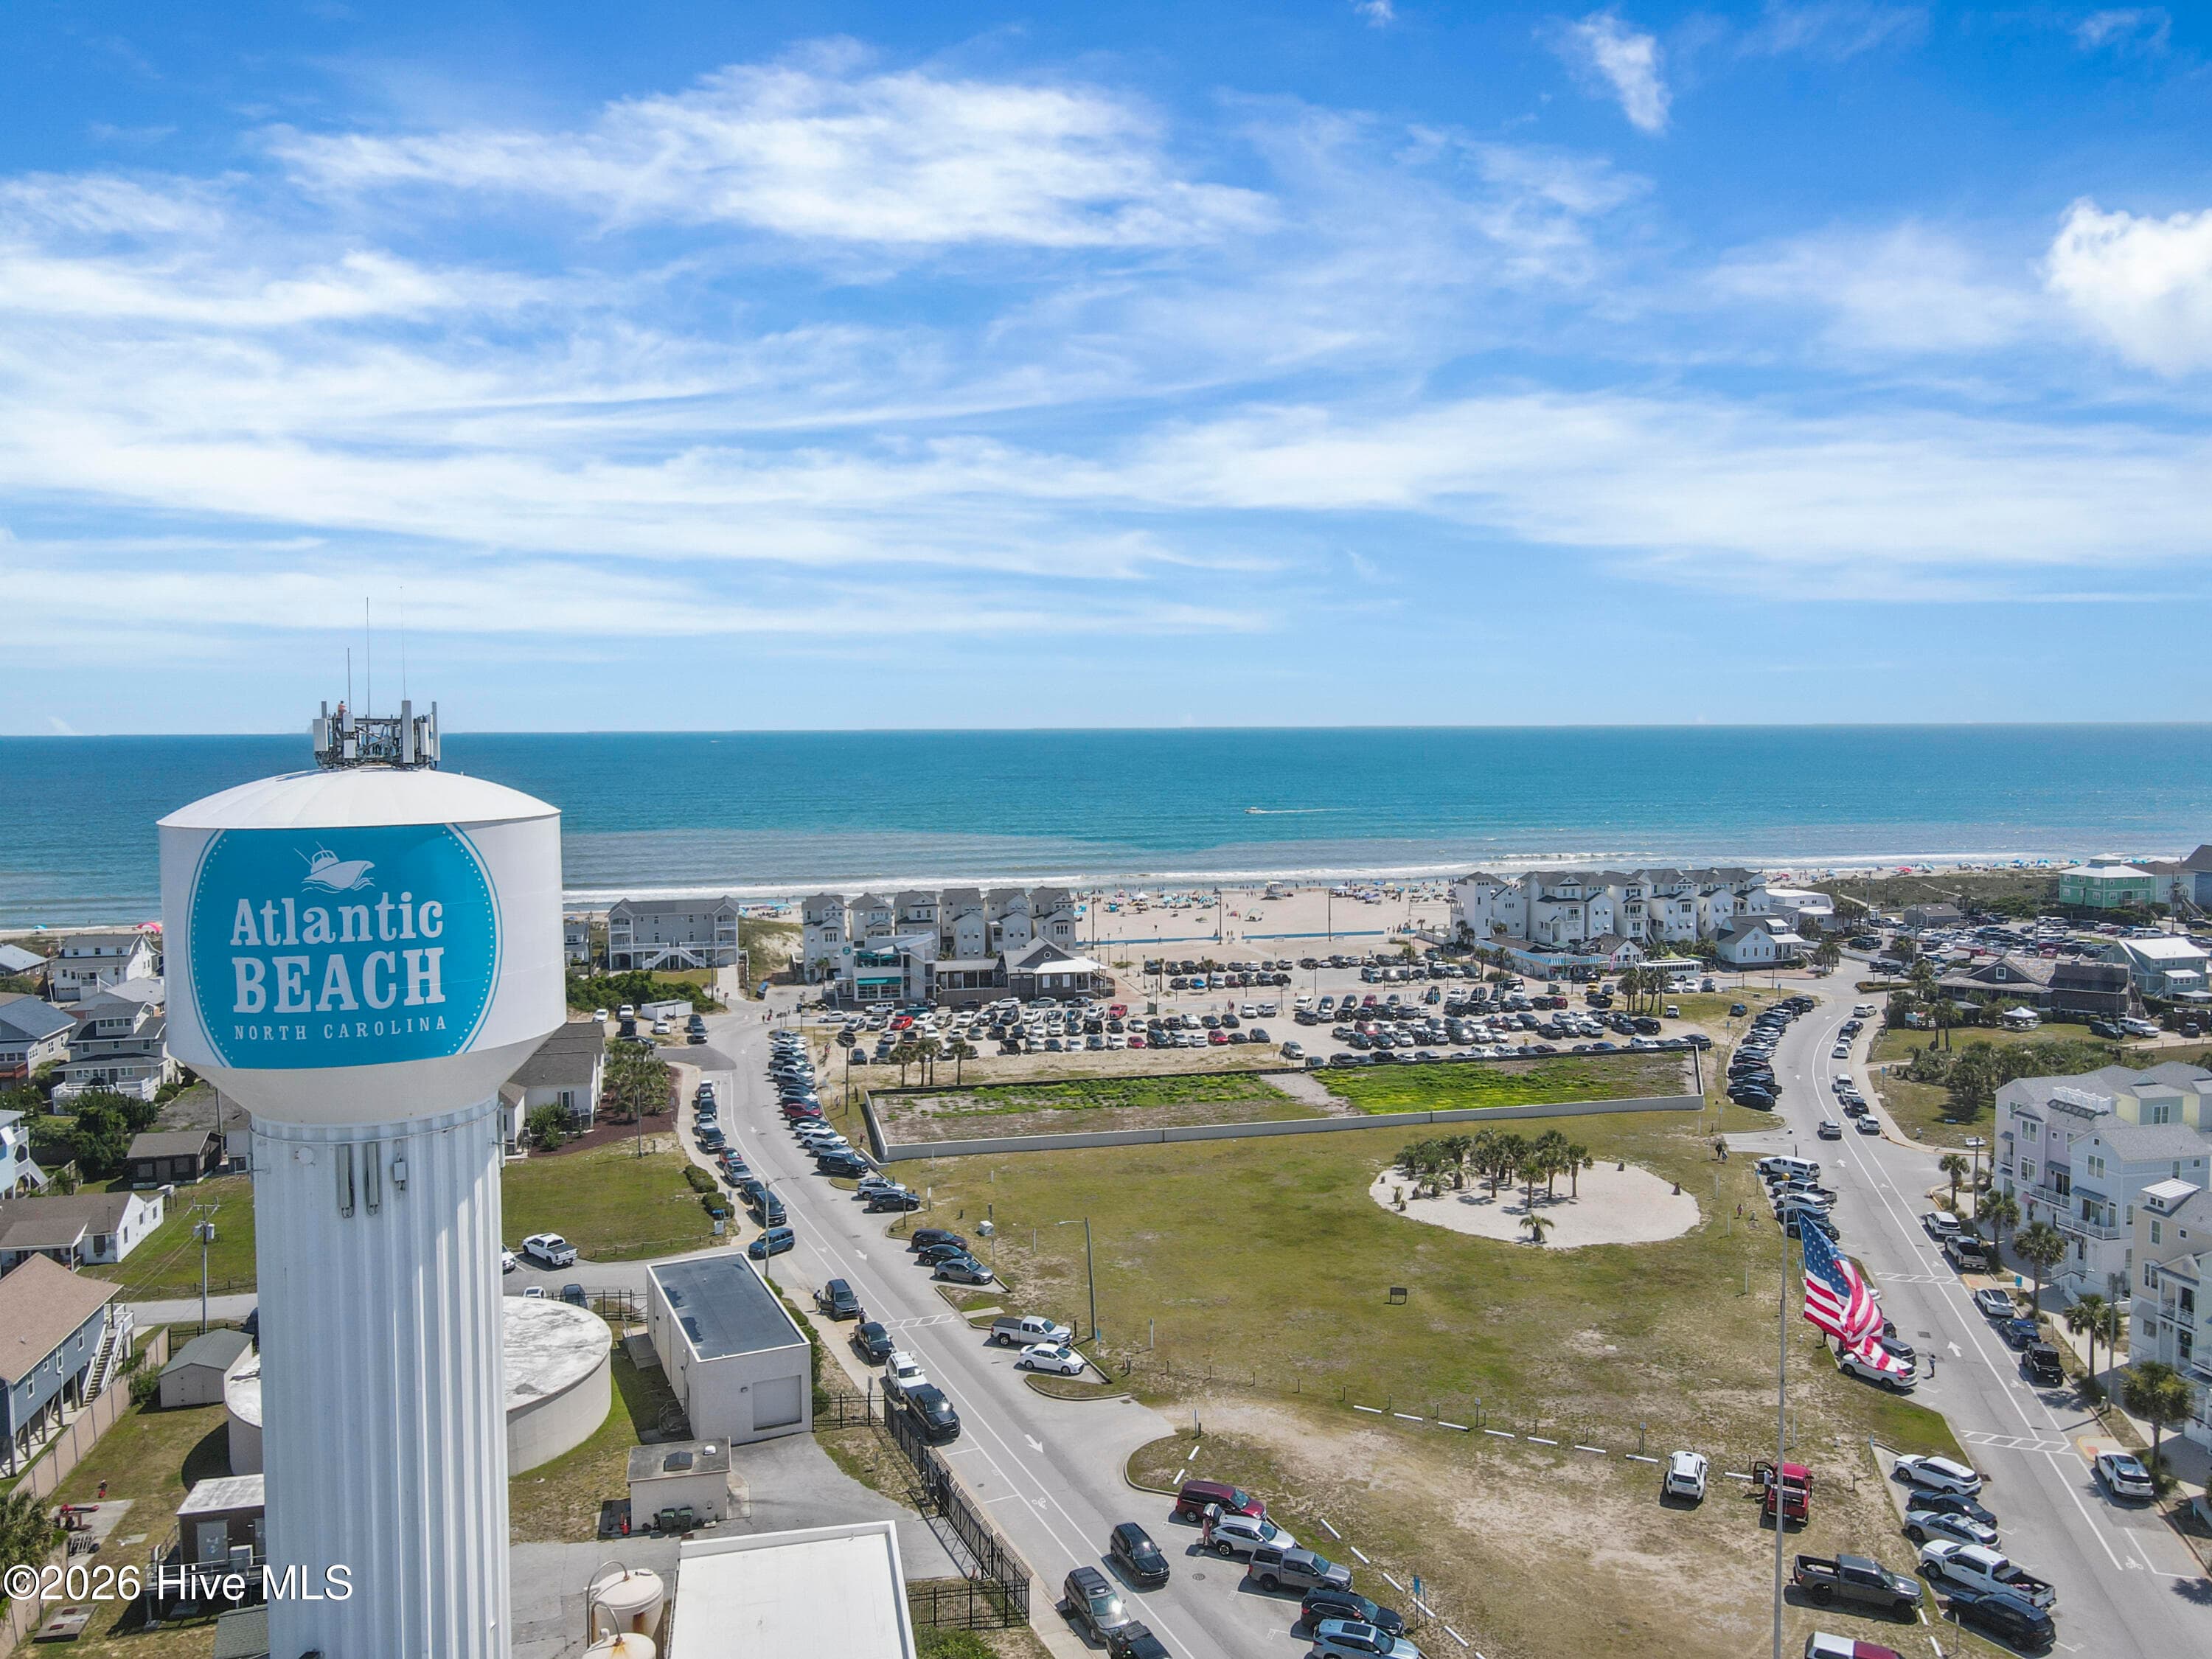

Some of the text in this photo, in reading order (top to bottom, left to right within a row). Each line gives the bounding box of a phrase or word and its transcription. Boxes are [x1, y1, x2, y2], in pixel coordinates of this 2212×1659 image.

[230, 891, 443, 946] Atlantic
[232, 947, 446, 1014] BEACH
[234, 1016, 446, 1040] NORTH CAROLINA
